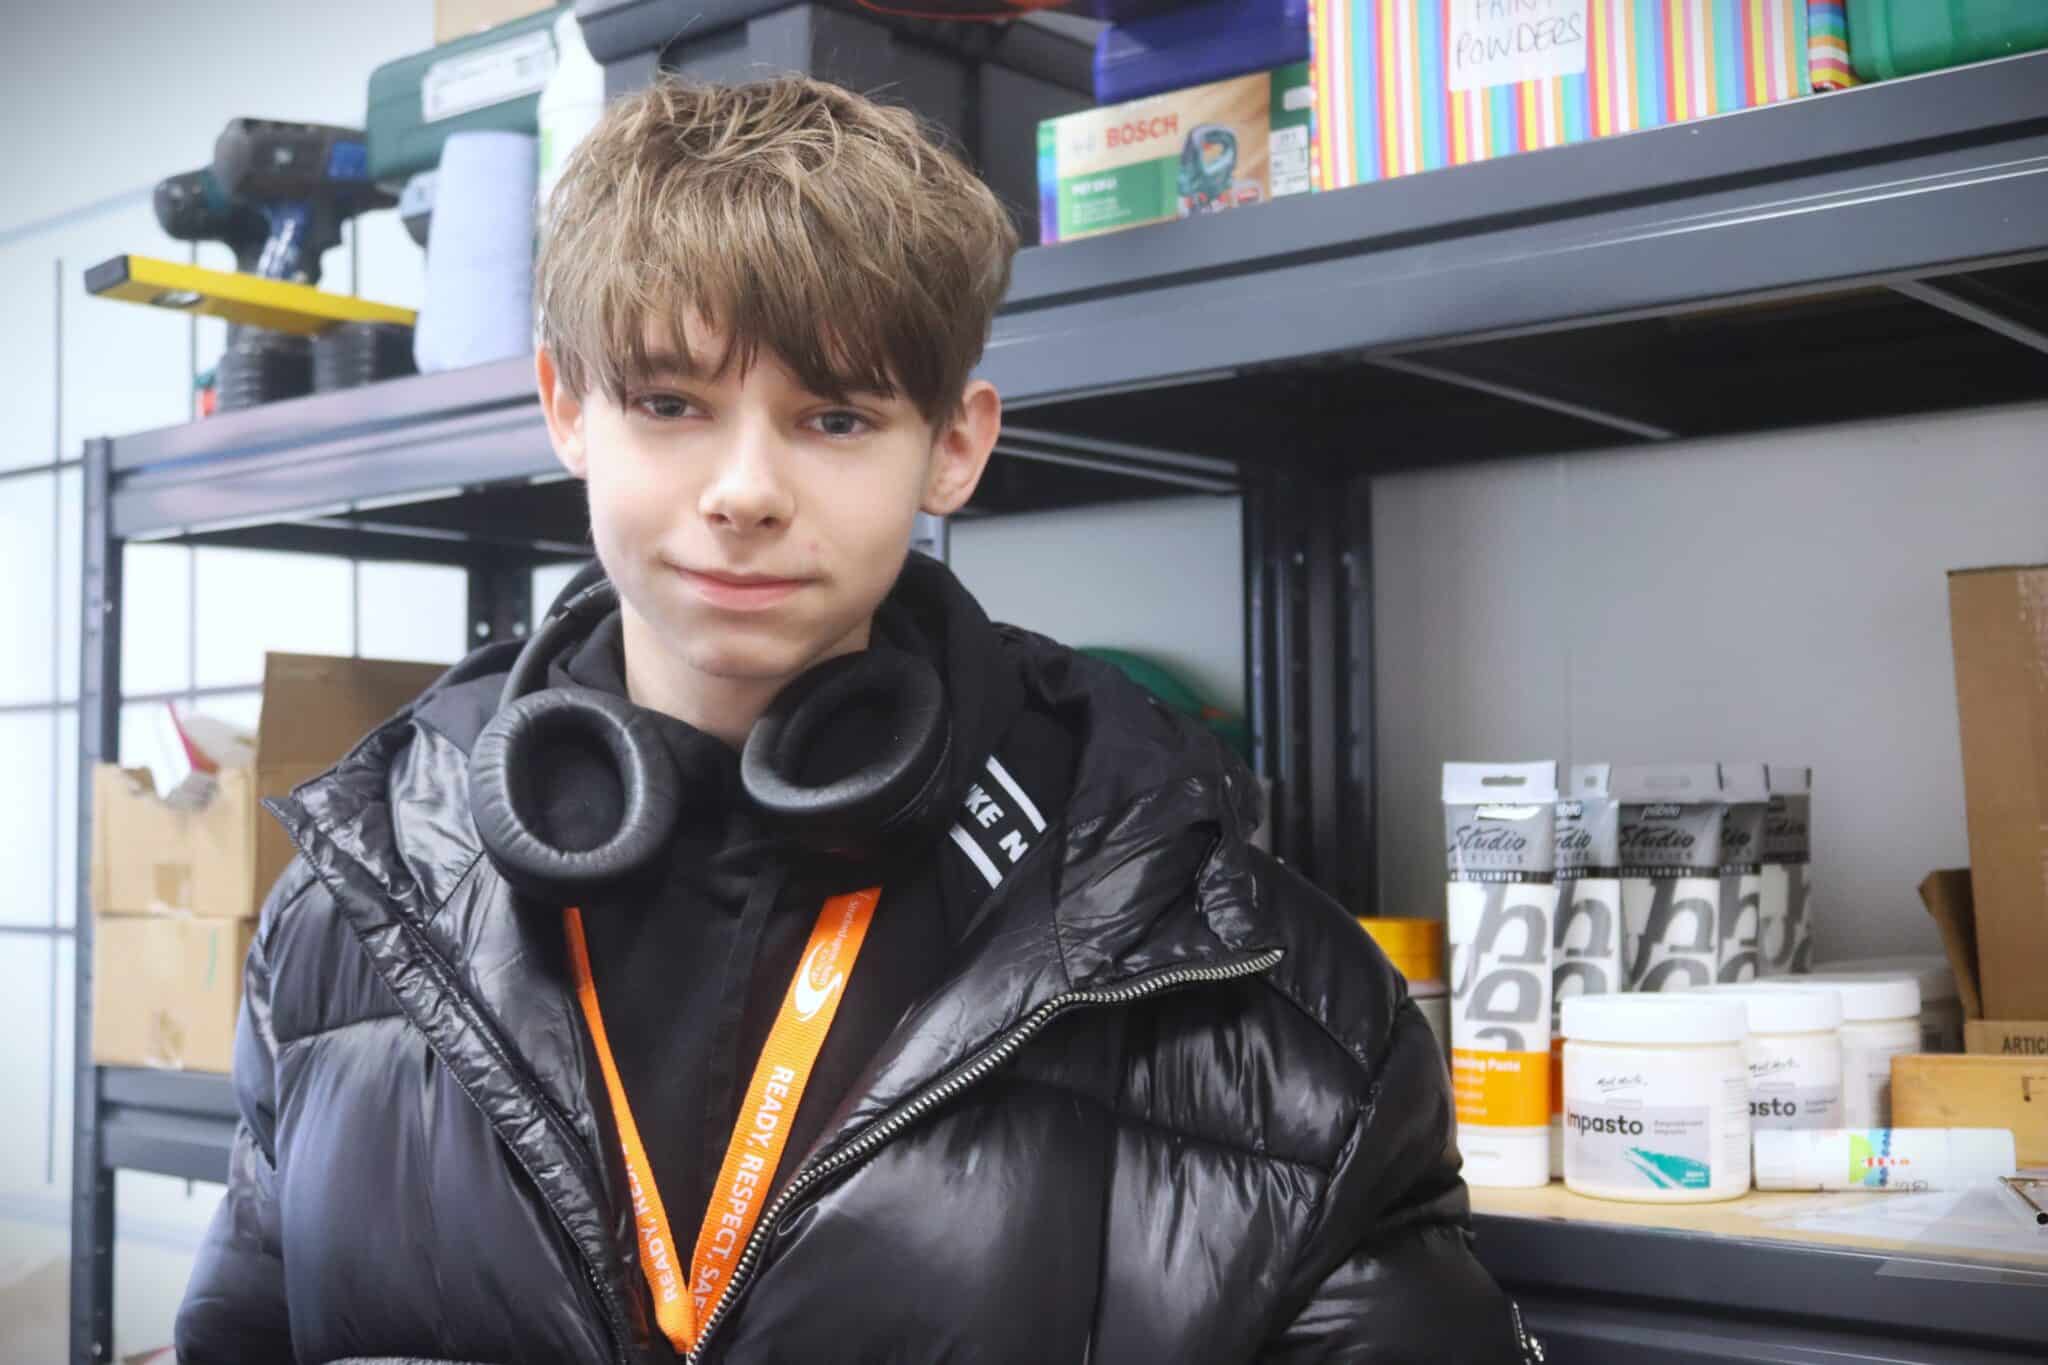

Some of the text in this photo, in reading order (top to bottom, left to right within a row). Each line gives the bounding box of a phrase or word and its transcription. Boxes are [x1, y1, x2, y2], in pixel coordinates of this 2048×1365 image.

[1456, 10, 1583, 71] POWDERS
[1106, 112, 1178, 148] BOSCH
[965, 783, 1004, 828] KE
[1448, 824, 1526, 853] Studio
[1620, 824, 1696, 848] Studio
[747, 1065, 795, 1149] READY,
[1567, 1106, 1644, 1136] Impasto
[1749, 1098, 1796, 1117] asto
[706, 1154, 764, 1260] RESPECT,
[642, 1218, 678, 1304] READY,
